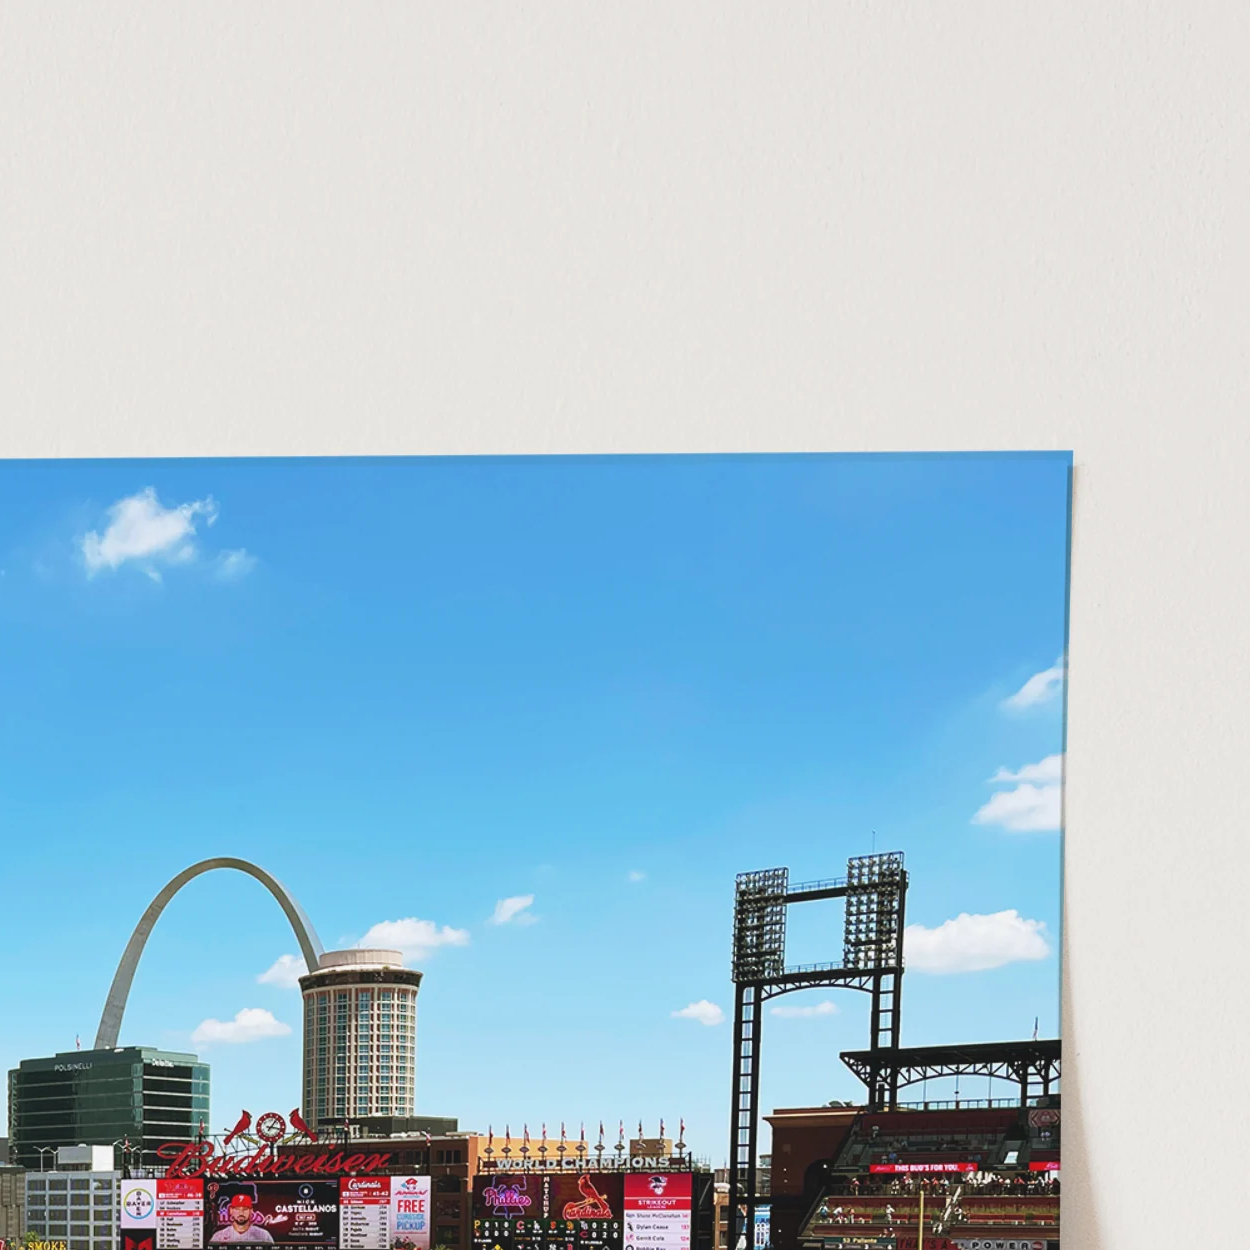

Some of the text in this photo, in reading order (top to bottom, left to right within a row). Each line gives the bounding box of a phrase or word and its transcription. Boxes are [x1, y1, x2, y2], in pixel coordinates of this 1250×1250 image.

[156, 1141, 392, 1178] Budweiser
[496, 1157, 670, 1169] WORLD CHAMPIONS
[275, 1205, 337, 1213] CASTELLANOS
[397, 1199, 425, 1213] FREE
[396, 1220, 426, 1231] PICKUP
[969, 1240, 1029, 1250] POWER
